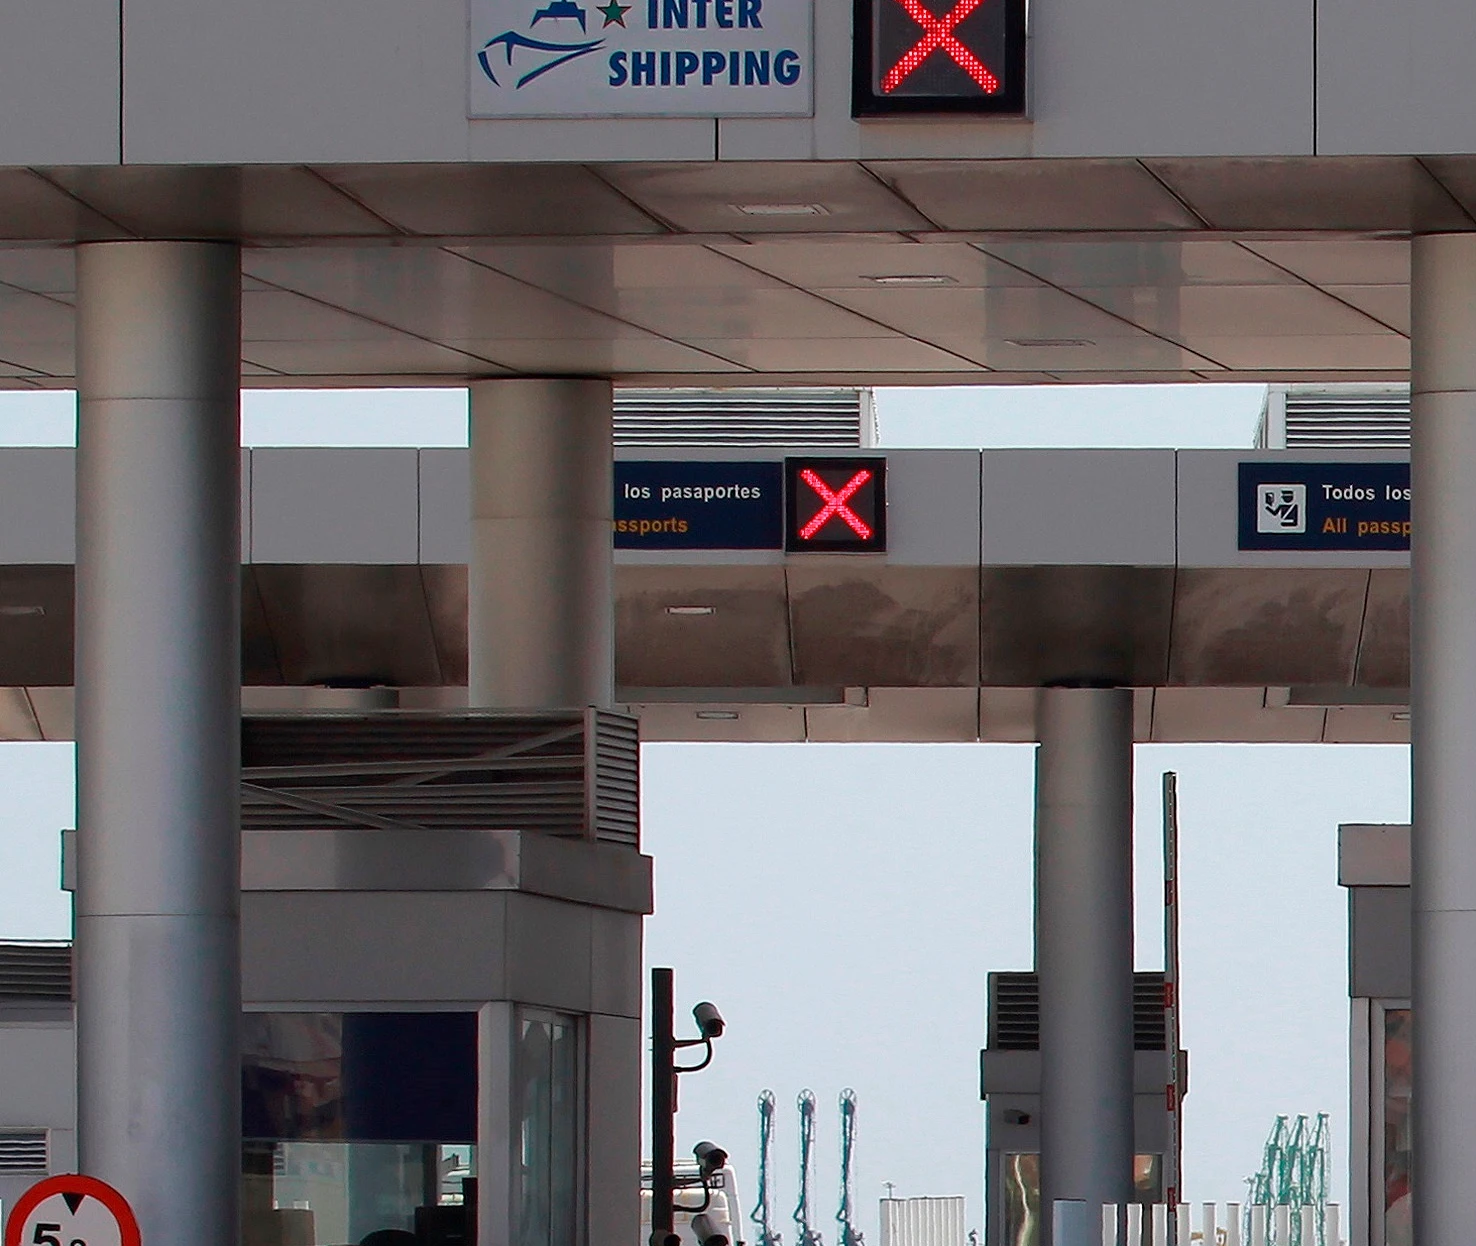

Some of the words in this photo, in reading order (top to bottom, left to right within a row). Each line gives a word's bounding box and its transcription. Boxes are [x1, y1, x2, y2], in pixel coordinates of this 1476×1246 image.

[647, 0, 764, 29] INTER
[608, 50, 801, 86] SHIPPING
[624, 483, 651, 499] los
[661, 485, 761, 502] pasaportes
[1322, 484, 1375, 500] Todos
[1386, 485, 1411, 500] los
[614, 517, 688, 535] ssports
[1323, 517, 1347, 534] All
[1358, 519, 1411, 537] passp
